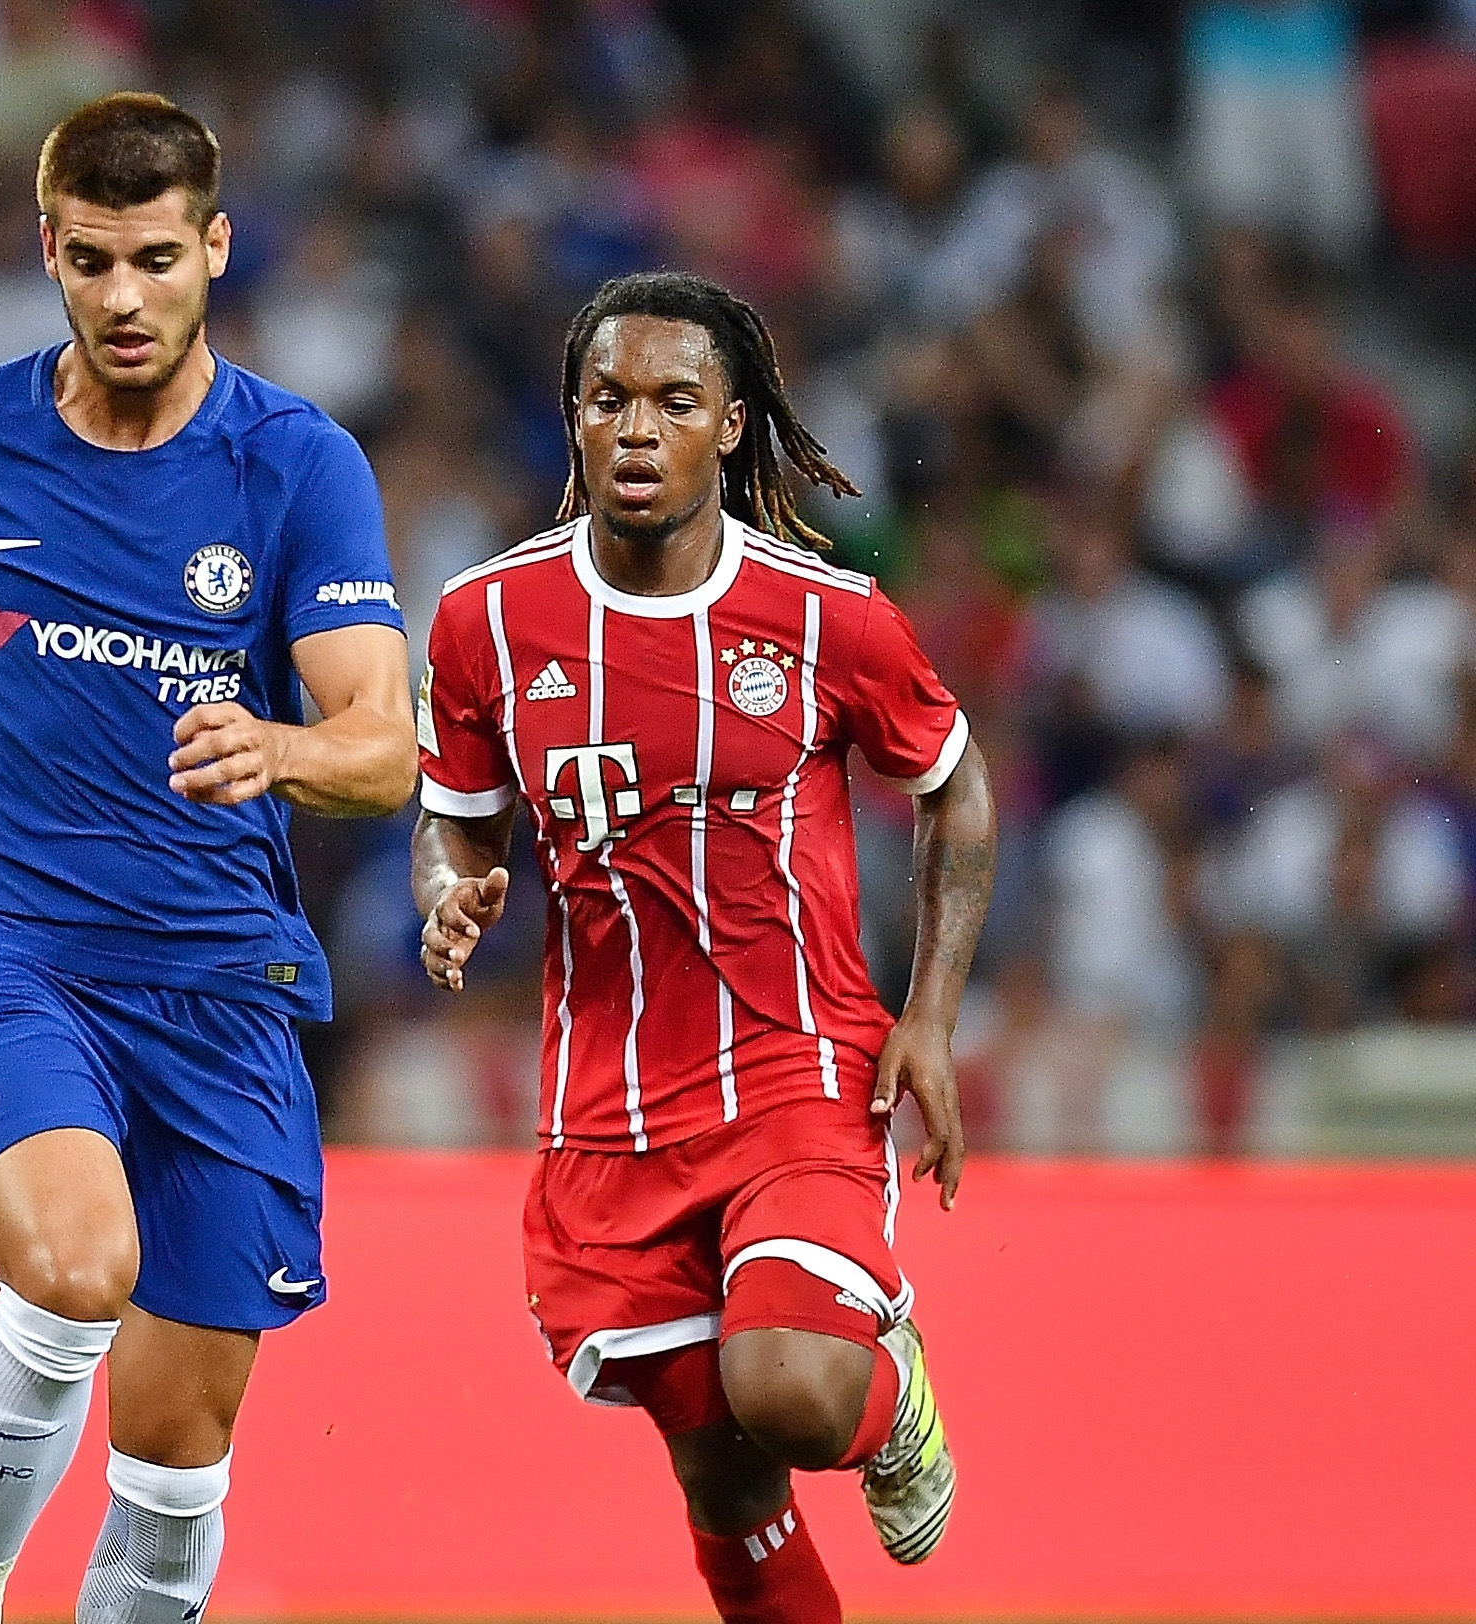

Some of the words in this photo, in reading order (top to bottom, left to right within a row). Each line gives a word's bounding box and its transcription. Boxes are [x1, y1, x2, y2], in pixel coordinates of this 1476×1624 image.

[29, 619, 247, 676] YOKOHAMA
[157, 673, 241, 703] TYRES
[526, 684, 577, 701] adidas
